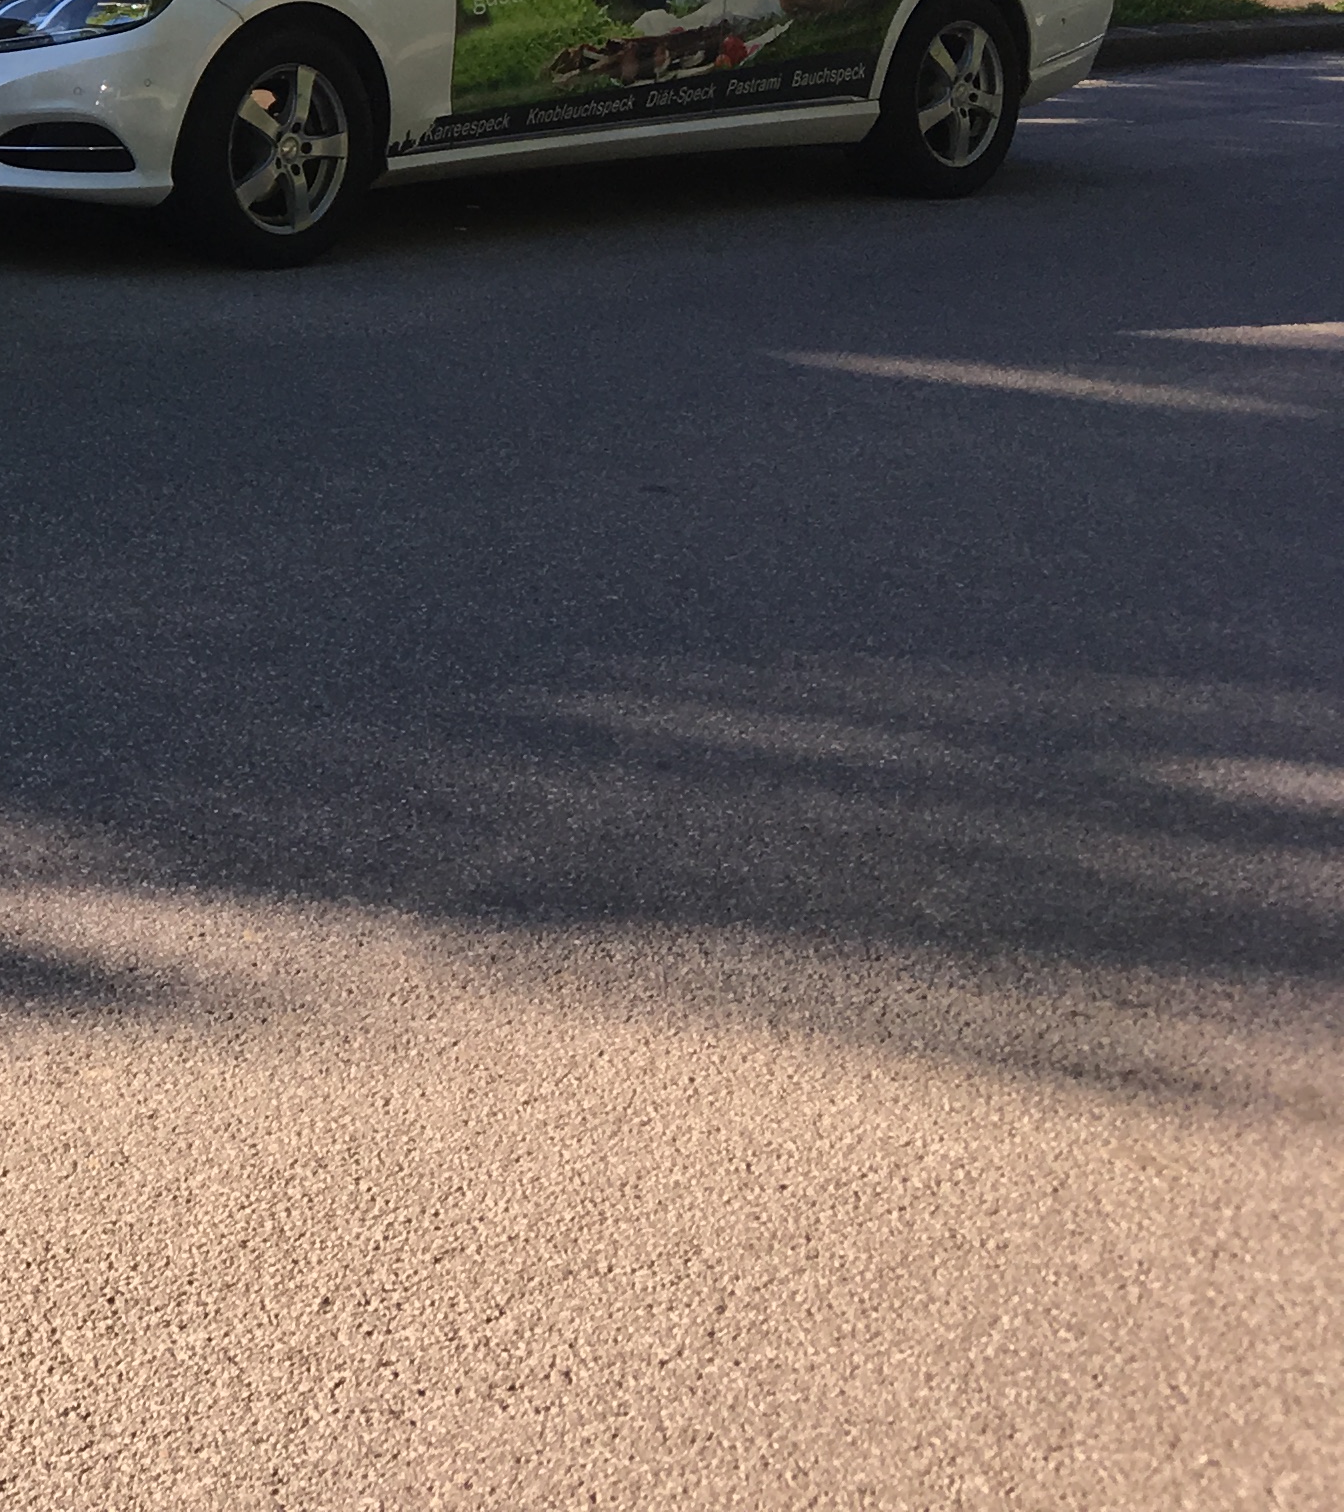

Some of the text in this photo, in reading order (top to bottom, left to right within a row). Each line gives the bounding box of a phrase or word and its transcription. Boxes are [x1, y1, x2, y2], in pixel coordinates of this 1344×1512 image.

[526, 94, 636, 127] Knoblauchspeck
[645, 83, 716, 108] Diät-Speck
[726, 73, 783, 97] Pastrami
[791, 63, 866, 89] Bauchspeck
